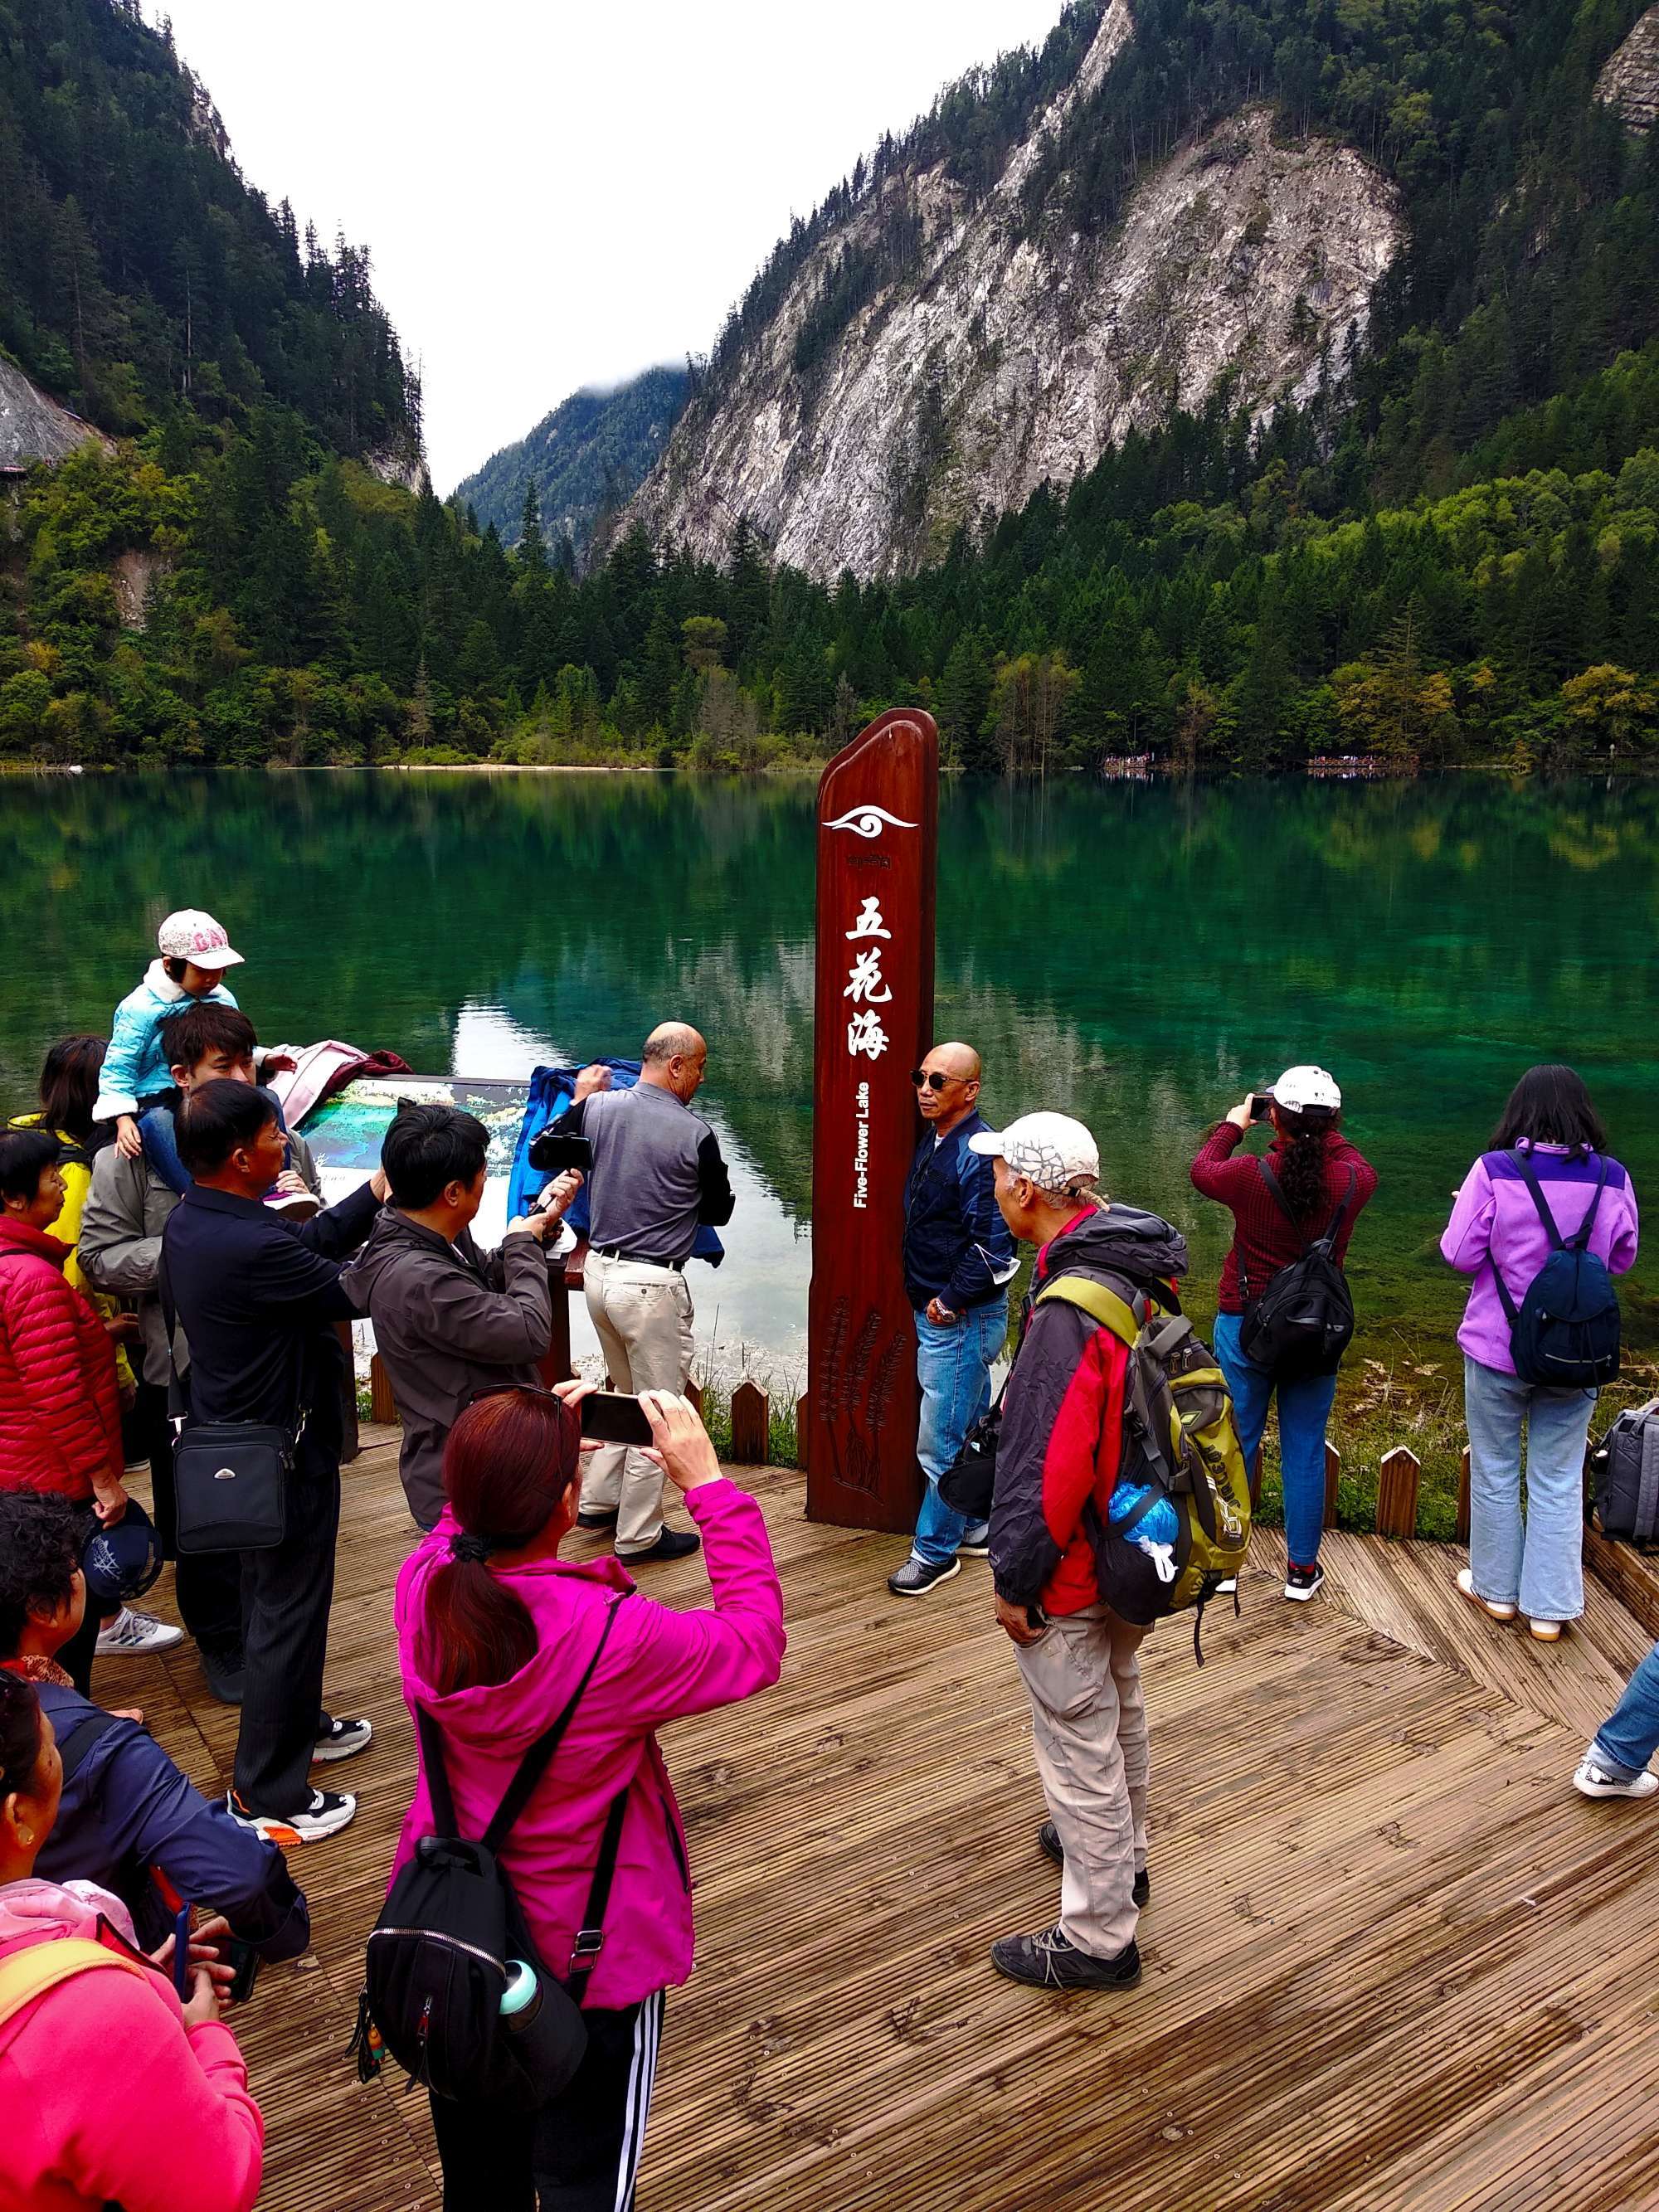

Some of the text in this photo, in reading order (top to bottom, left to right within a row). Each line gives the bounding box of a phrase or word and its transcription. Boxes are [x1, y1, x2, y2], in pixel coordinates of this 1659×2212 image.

[844, 896, 893, 1061] 五花海
[854, 1082, 869, 1208] Five-Flower Lake
